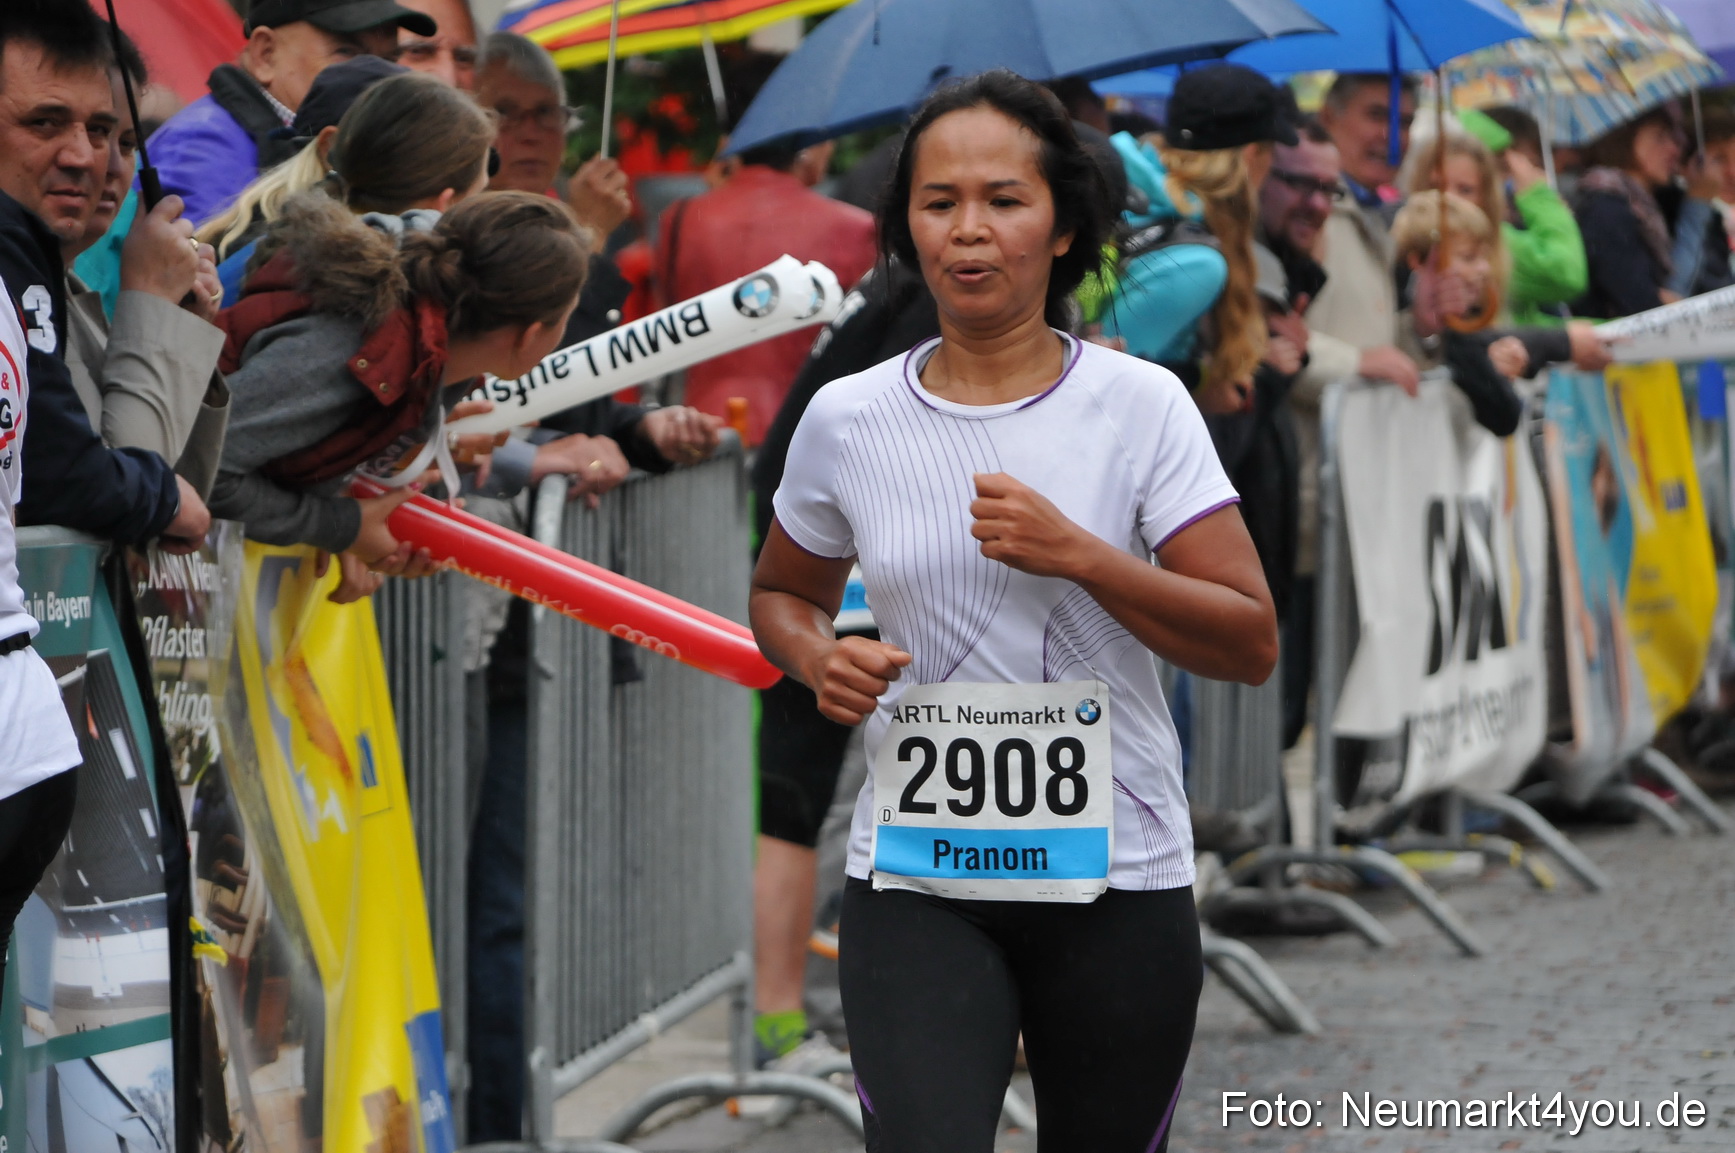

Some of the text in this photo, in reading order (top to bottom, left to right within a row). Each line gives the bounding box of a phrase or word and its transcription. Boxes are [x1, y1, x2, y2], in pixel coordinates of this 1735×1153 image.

[608, 301, 713, 370] BMW
[33, 591, 45, 622] in
[46, 591, 92, 628] Bayern
[891, 704, 1066, 725] ARTL Neumarkt
[897, 736, 1089, 818] 2908
[933, 839, 1048, 871] Pranom
